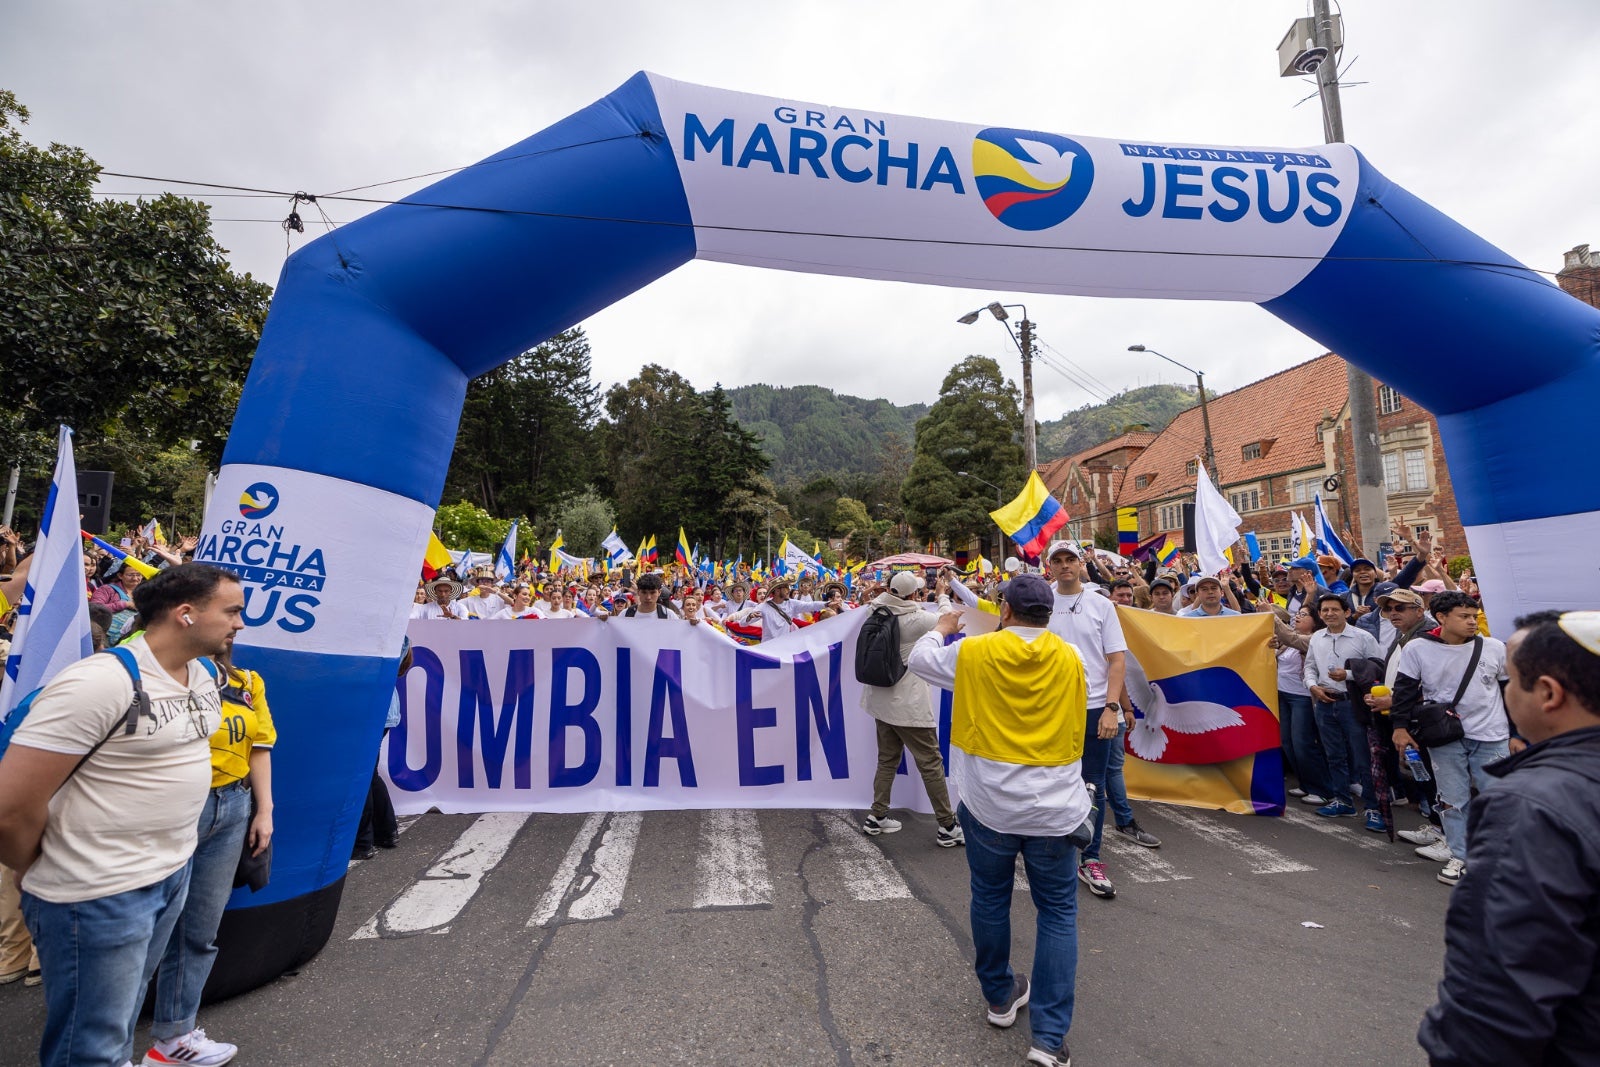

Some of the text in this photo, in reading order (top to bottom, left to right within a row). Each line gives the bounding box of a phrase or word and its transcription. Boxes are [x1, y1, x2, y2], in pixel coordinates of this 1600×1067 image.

[774, 106, 886, 137] GRAN
[683, 112, 966, 195] MARCHA
[1126, 145, 1327, 167] NACIONAL PARA
[1121, 161, 1343, 228] JESÚS
[221, 519, 285, 541] GRAN
[263, 572, 319, 590] PARA
[224, 715, 246, 745] 10
[387, 646, 698, 792] OMBIA
[735, 641, 850, 788] EN
